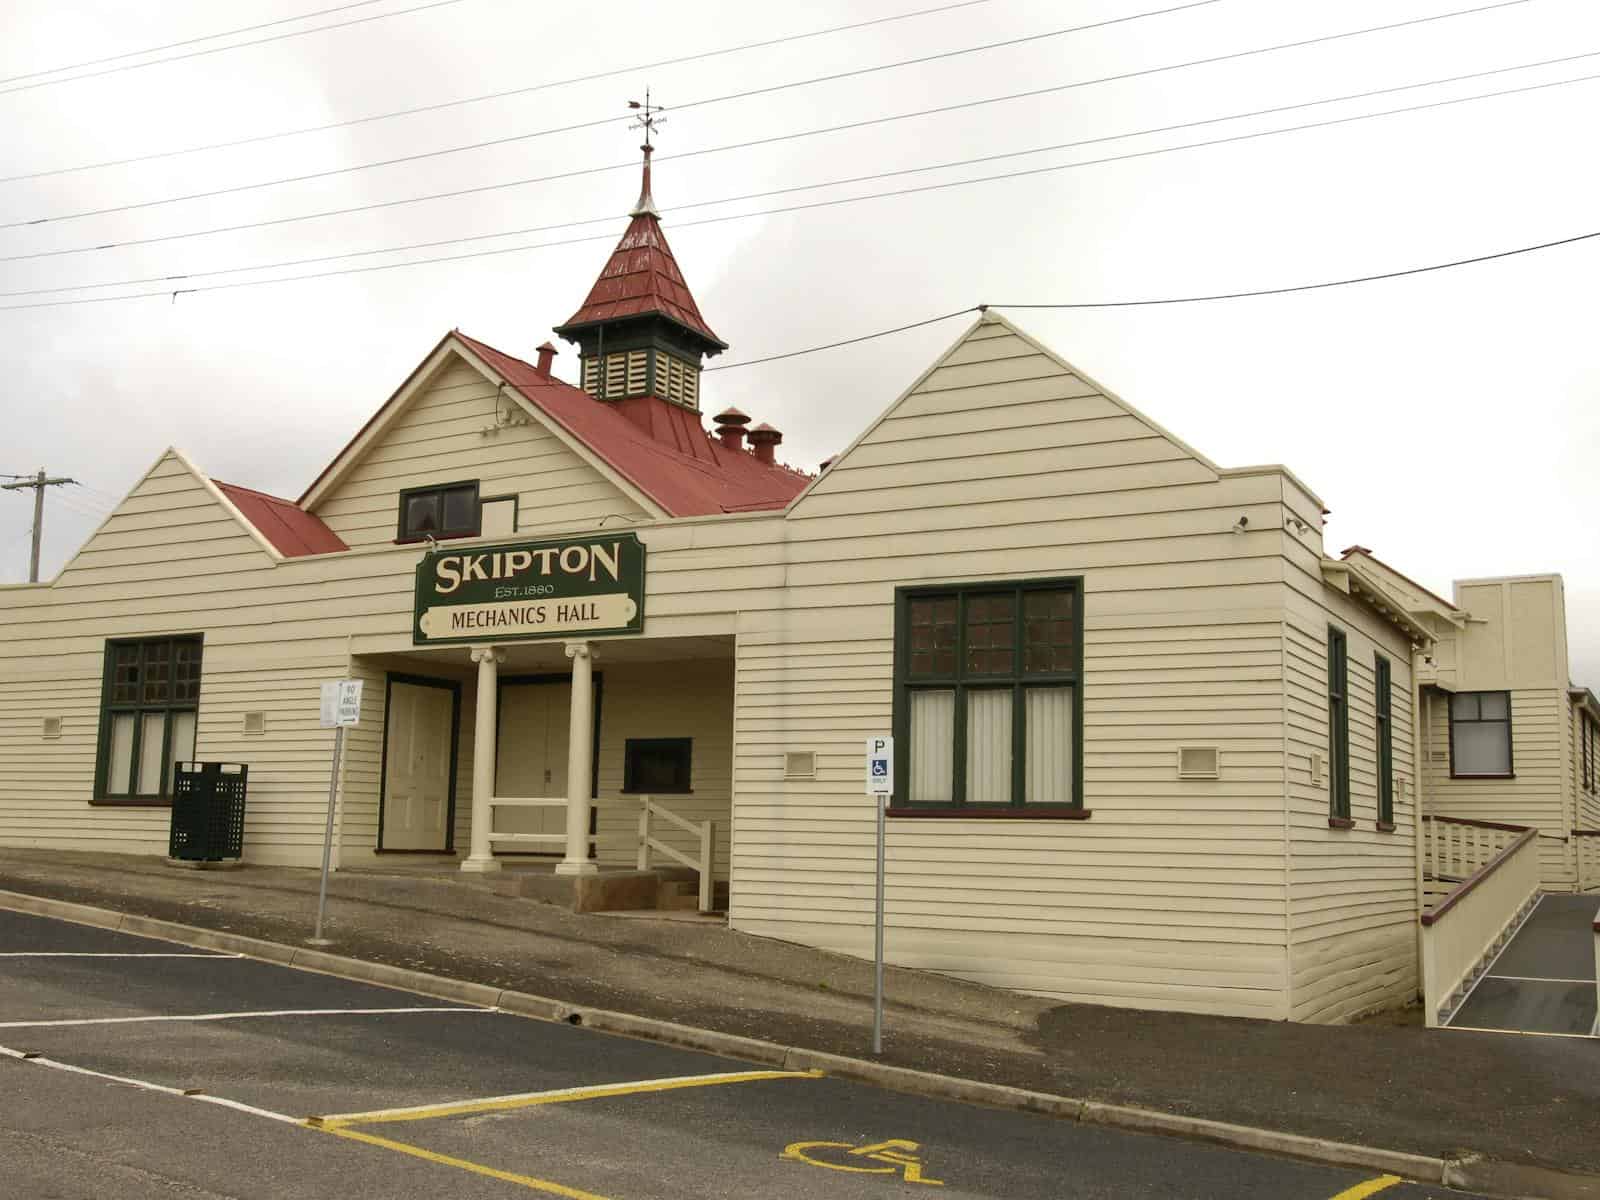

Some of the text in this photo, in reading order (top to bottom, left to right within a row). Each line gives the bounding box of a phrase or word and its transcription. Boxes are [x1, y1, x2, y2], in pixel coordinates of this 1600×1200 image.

[434, 542, 621, 593] SKIPTON
[451, 602, 600, 629] MECHANICS HALL
[874, 739, 885, 753] P
